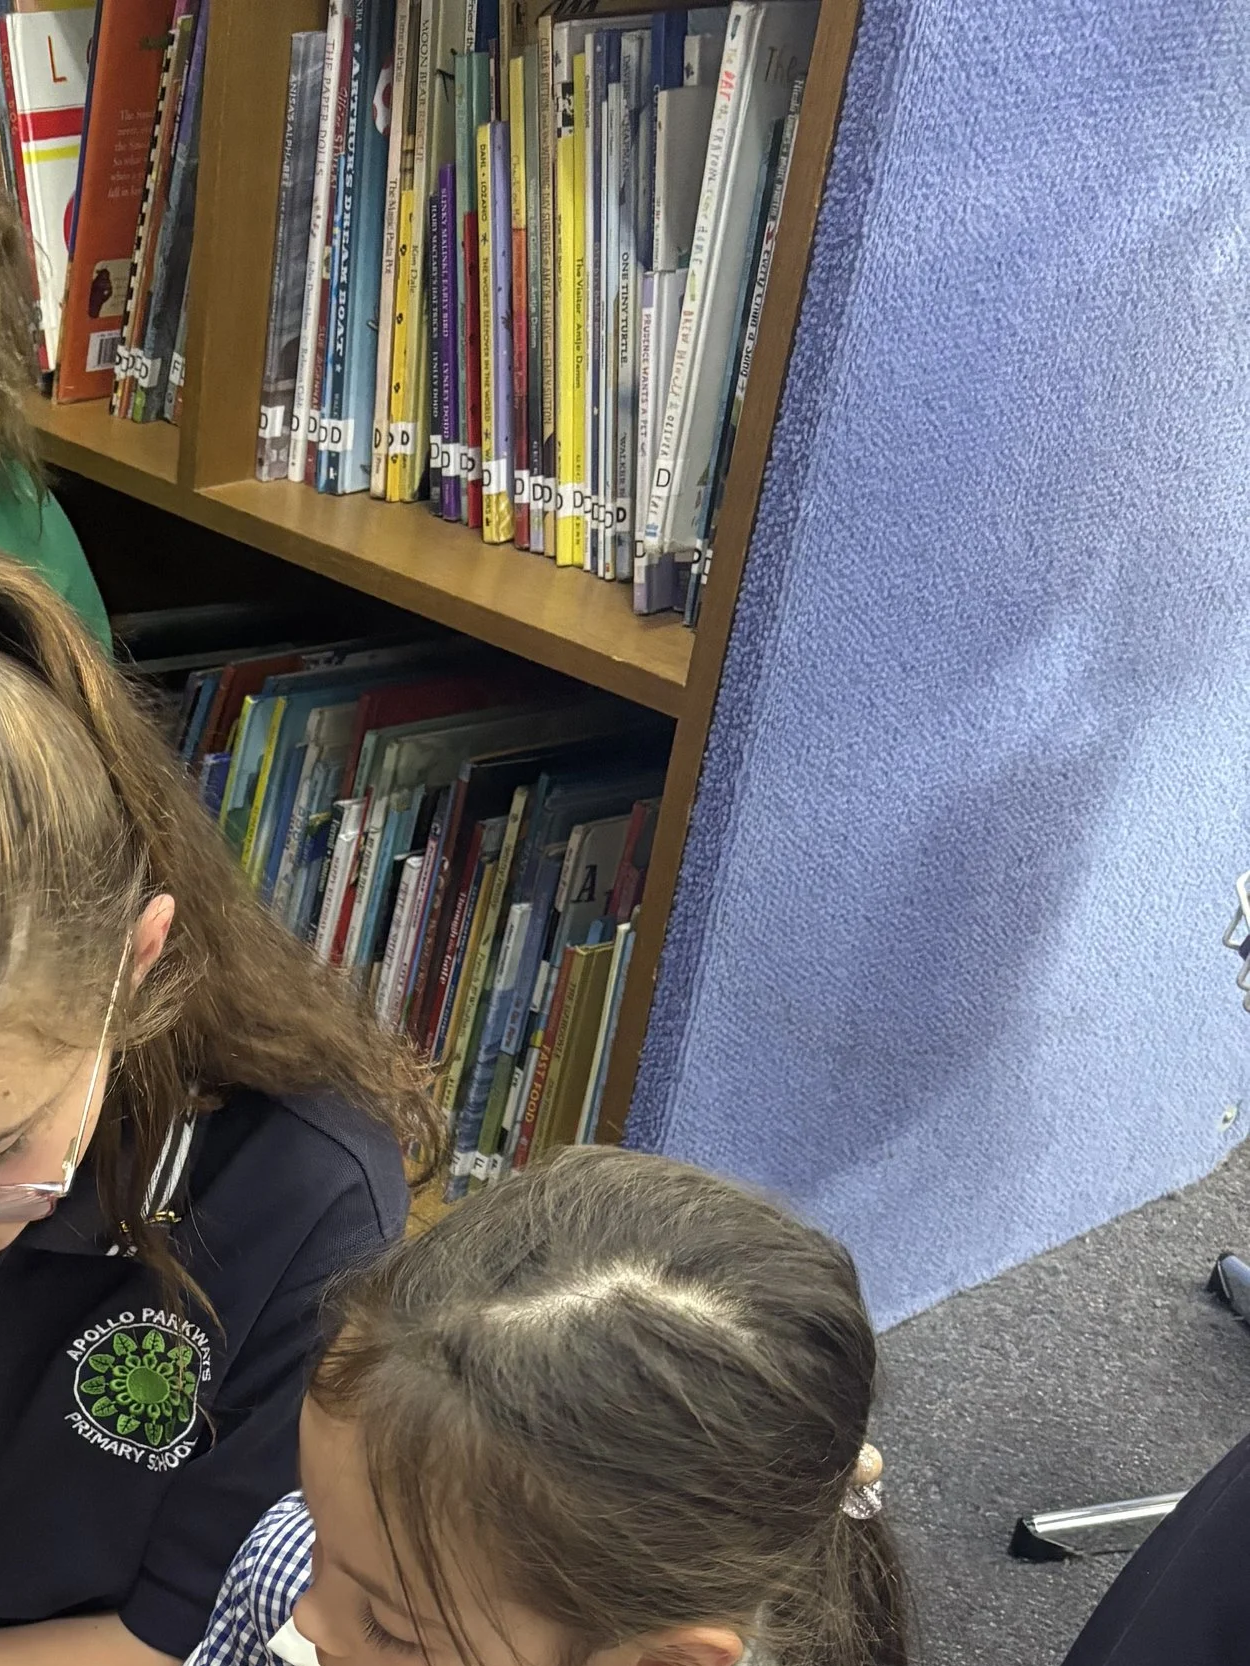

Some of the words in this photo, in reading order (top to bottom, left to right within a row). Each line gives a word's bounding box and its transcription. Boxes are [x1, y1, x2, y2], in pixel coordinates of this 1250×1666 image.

[324, 38, 334, 70] THE
[419, 19, 429, 67] MOON
[287, 72, 298, 121] ANISA'S
[320, 77, 331, 121] PAPER
[419, 71, 427, 105] BEAR
[540, 72, 549, 111] BUTTON
[718, 70, 734, 101] DAY
[345, 56, 360, 187] ARTHUR'S
[415, 109, 425, 164] RESCUE
[281, 123, 293, 187] ALPHABET
[315, 129, 326, 176] DOLLS
[541, 193, 549, 210] DAY
[339, 194, 351, 283] DREAM
[541, 212, 550, 256] SURPRISE
[575, 257, 583, 277] The
[620, 251, 630, 280] ONE
[619, 283, 628, 314] TINY
[336, 290, 346, 356] BOAT
[574, 324, 582, 351] Antje
[640, 312, 651, 363] PRUDENCE
[575, 355, 583, 388] Damm
[641, 366, 649, 404] WANTS
[308, 416, 317, 433] D
[319, 426, 328, 443] D
[331, 426, 342, 444] D
[374, 428, 382, 449] D
[401, 430, 410, 446] D
[430, 442, 440, 460] D
[441, 451, 450, 468] D
[482, 469, 492, 487] D
[514, 478, 525, 495] D
[533, 483, 544, 501] D
[656, 468, 671, 488] D
[573, 490, 583, 508] D
[616, 507, 627, 523] D
[536, 1044, 551, 1076] FAST
[523, 1081, 542, 1123] FOOD
[66, 1311, 135, 1362] APOLLO
[64, 1411, 145, 1463] PRIMARY
[147, 1437, 198, 1472] SHOOL
